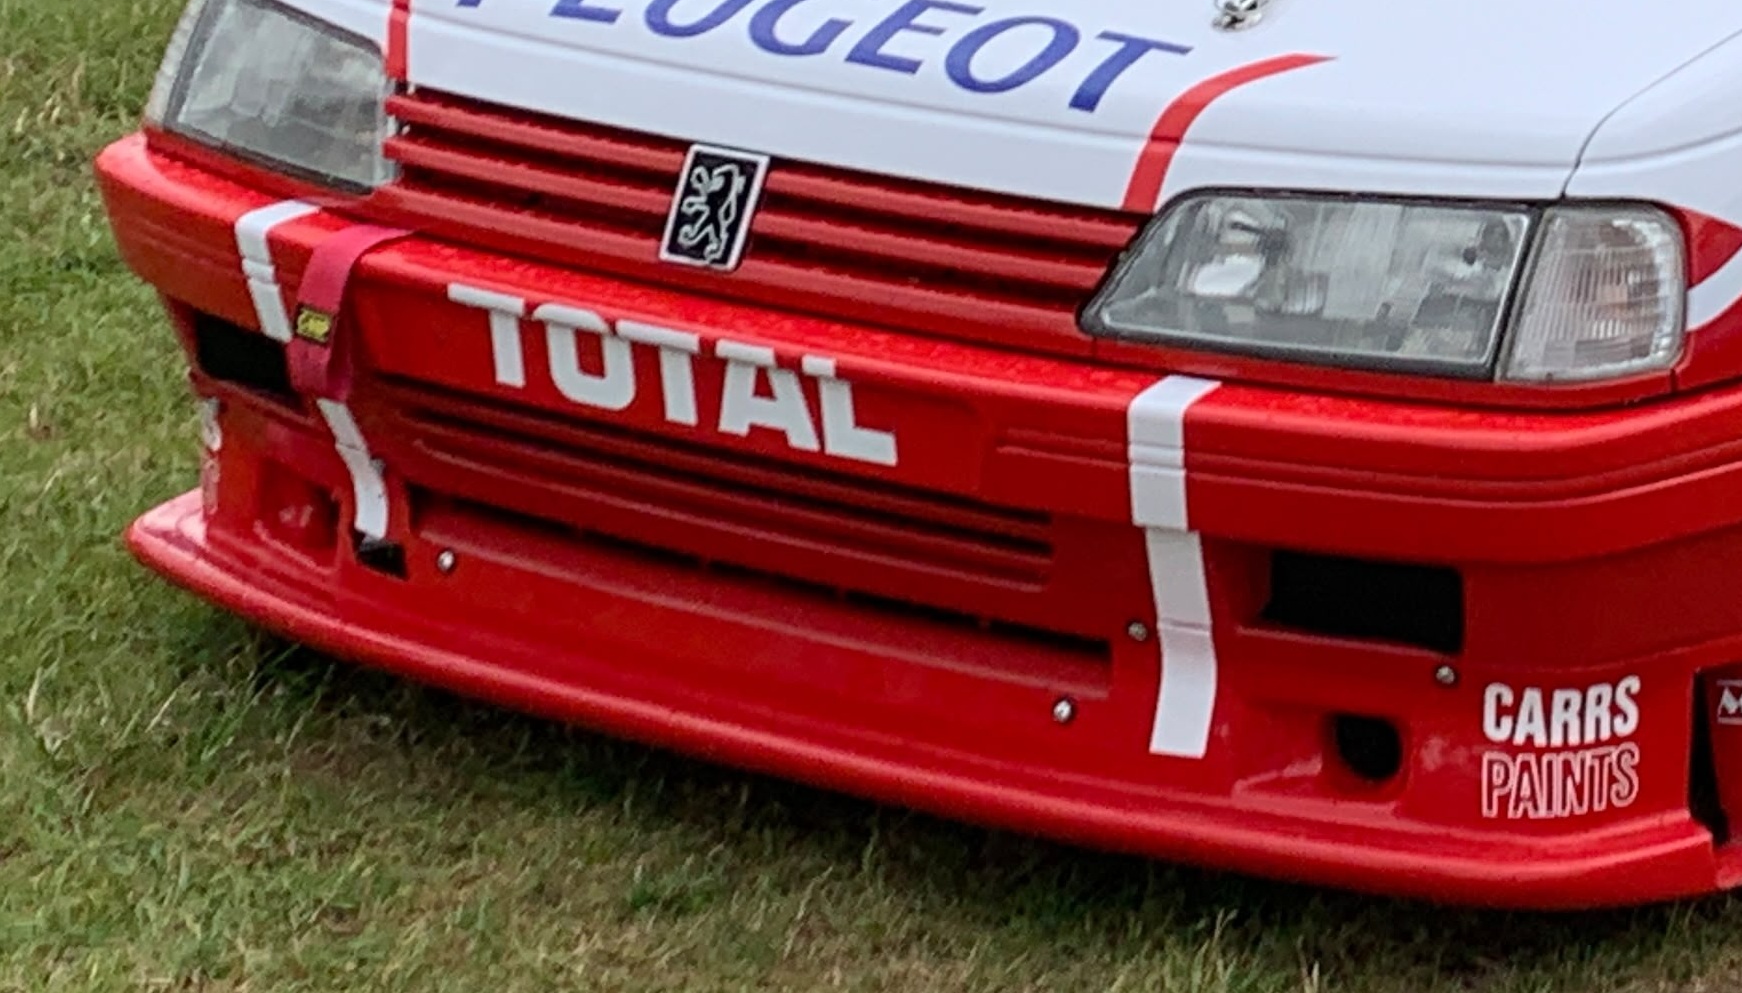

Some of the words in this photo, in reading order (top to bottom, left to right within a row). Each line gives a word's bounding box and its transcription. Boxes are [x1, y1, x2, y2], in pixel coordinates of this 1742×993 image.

[447, 282, 897, 466] TOTAL
[1483, 675, 1640, 747] CARRS
[1481, 742, 1640, 819] PAINTS
